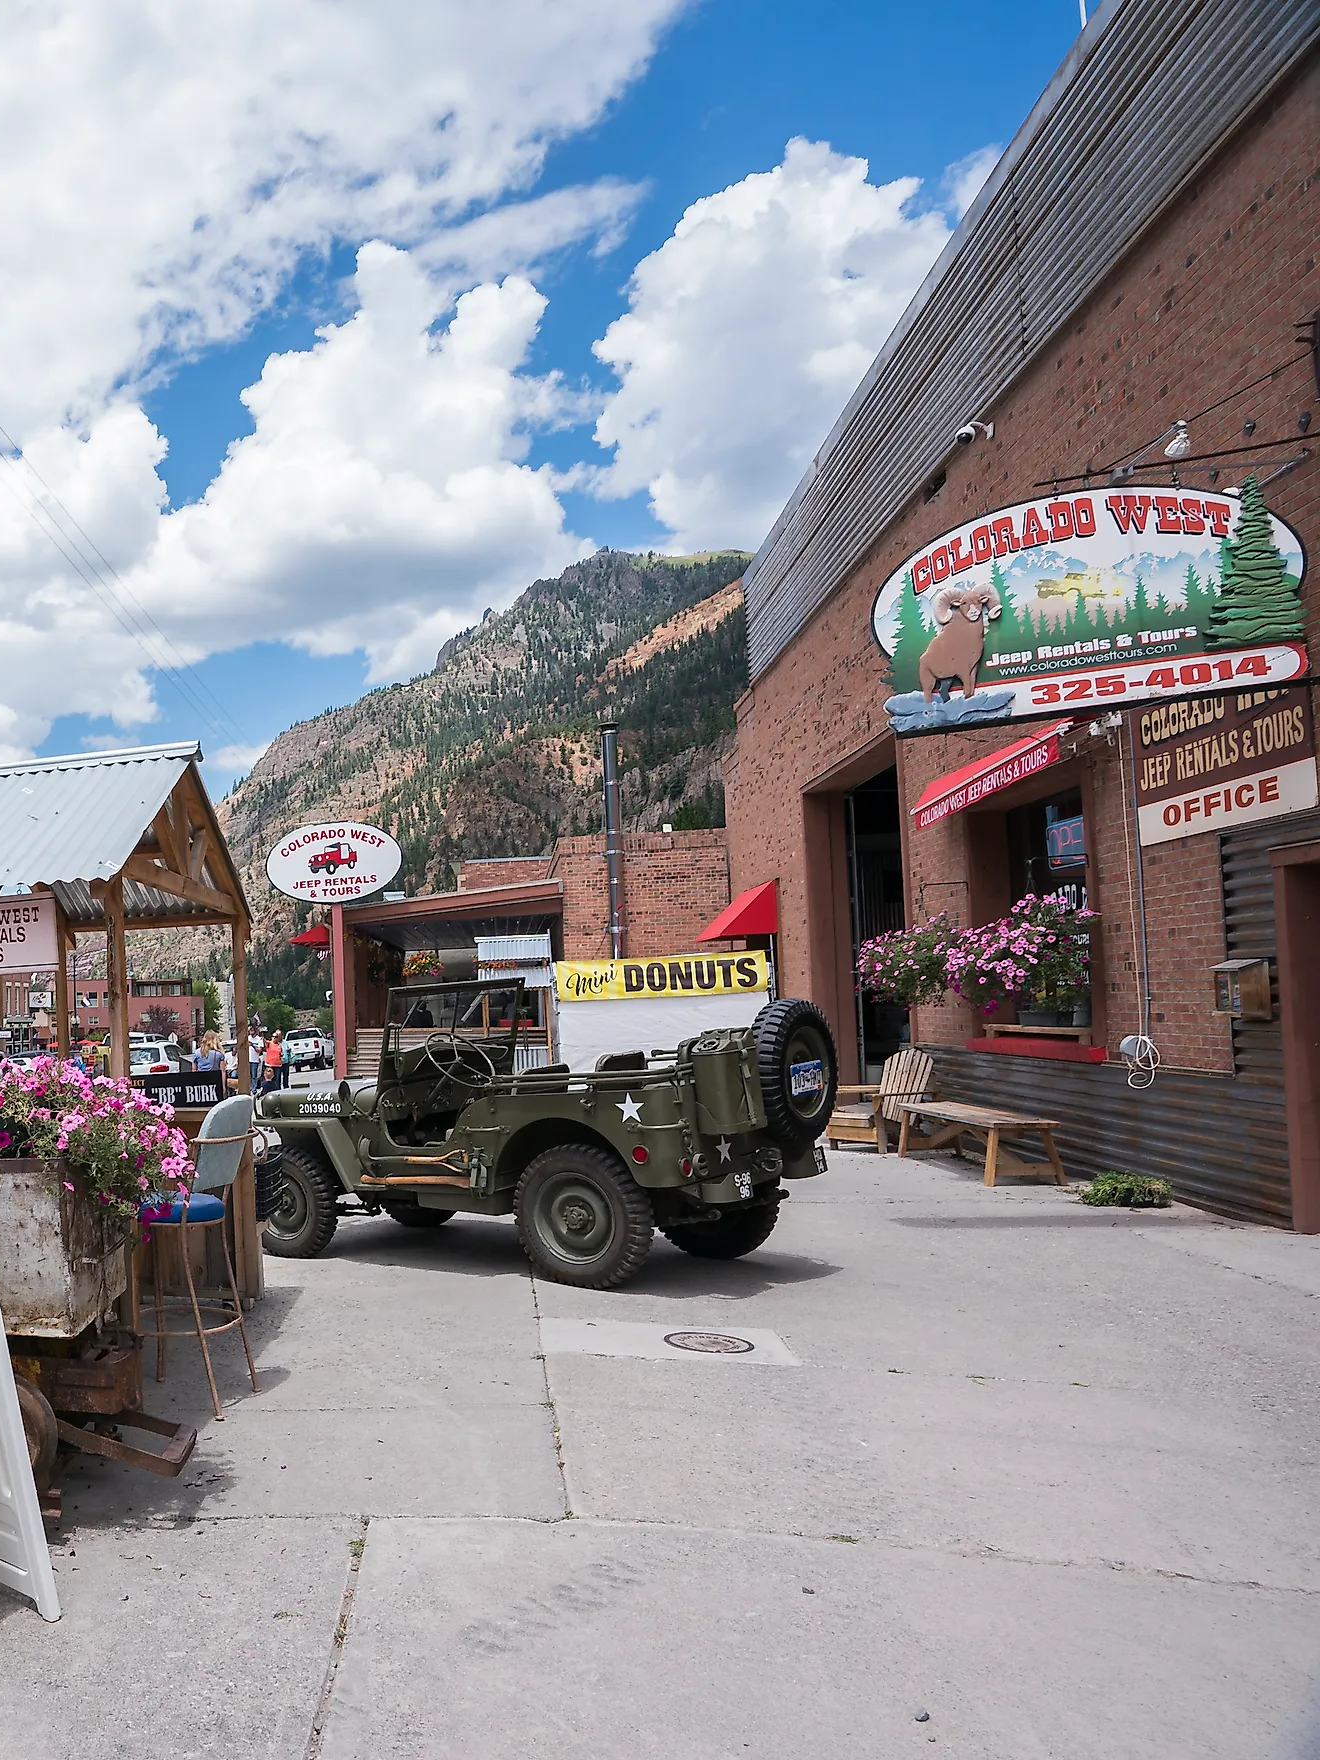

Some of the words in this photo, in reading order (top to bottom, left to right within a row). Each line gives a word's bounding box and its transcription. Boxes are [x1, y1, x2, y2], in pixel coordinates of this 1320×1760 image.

[910, 497, 1097, 595] COLORADO
[1105, 495, 1232, 539] WEST
[986, 646, 1033, 668] Jeep
[1036, 639, 1111, 661] Rentals
[1116, 634, 1133, 648] &
[1137, 625, 1198, 646] Tours
[999, 642, 1178, 676] www.coloradowesttours.com
[1030, 654, 1272, 705] 325-4014
[1141, 696, 1225, 746] COLORADO
[1140, 752, 1171, 791] JEEP
[1176, 730, 1238, 781] RENTALS
[1242, 729, 1255, 759] &
[1253, 705, 1304, 756] TOURS
[920, 804, 949, 827] COLORADO
[949, 789, 967, 811] WEST
[967, 781, 981, 803] JEEP
[981, 764, 1013, 794] RENTALS
[1013, 761, 1020, 777] &
[1020, 745, 1049, 775] TOURS
[1163, 776, 1280, 827] OFFICE
[280, 828, 345, 857] COLORADO
[350, 829, 385, 848] WEST
[293, 879, 321, 890] JEEP
[324, 874, 377, 887] RENTALS
[309, 890, 317, 898] &
[322, 886, 361, 897] TOURS
[565, 963, 618, 997] Mini
[623, 957, 758, 992] DONUTS
[151, 1086, 182, 1104] "BB"
[185, 1084, 218, 1103] BURK
[299, 1103, 341, 1114] 20139040
[306, 1092, 334, 1101] U.S.A.
[734, 1171, 752, 1187] S-96
[739, 1185, 750, 1199] 96
